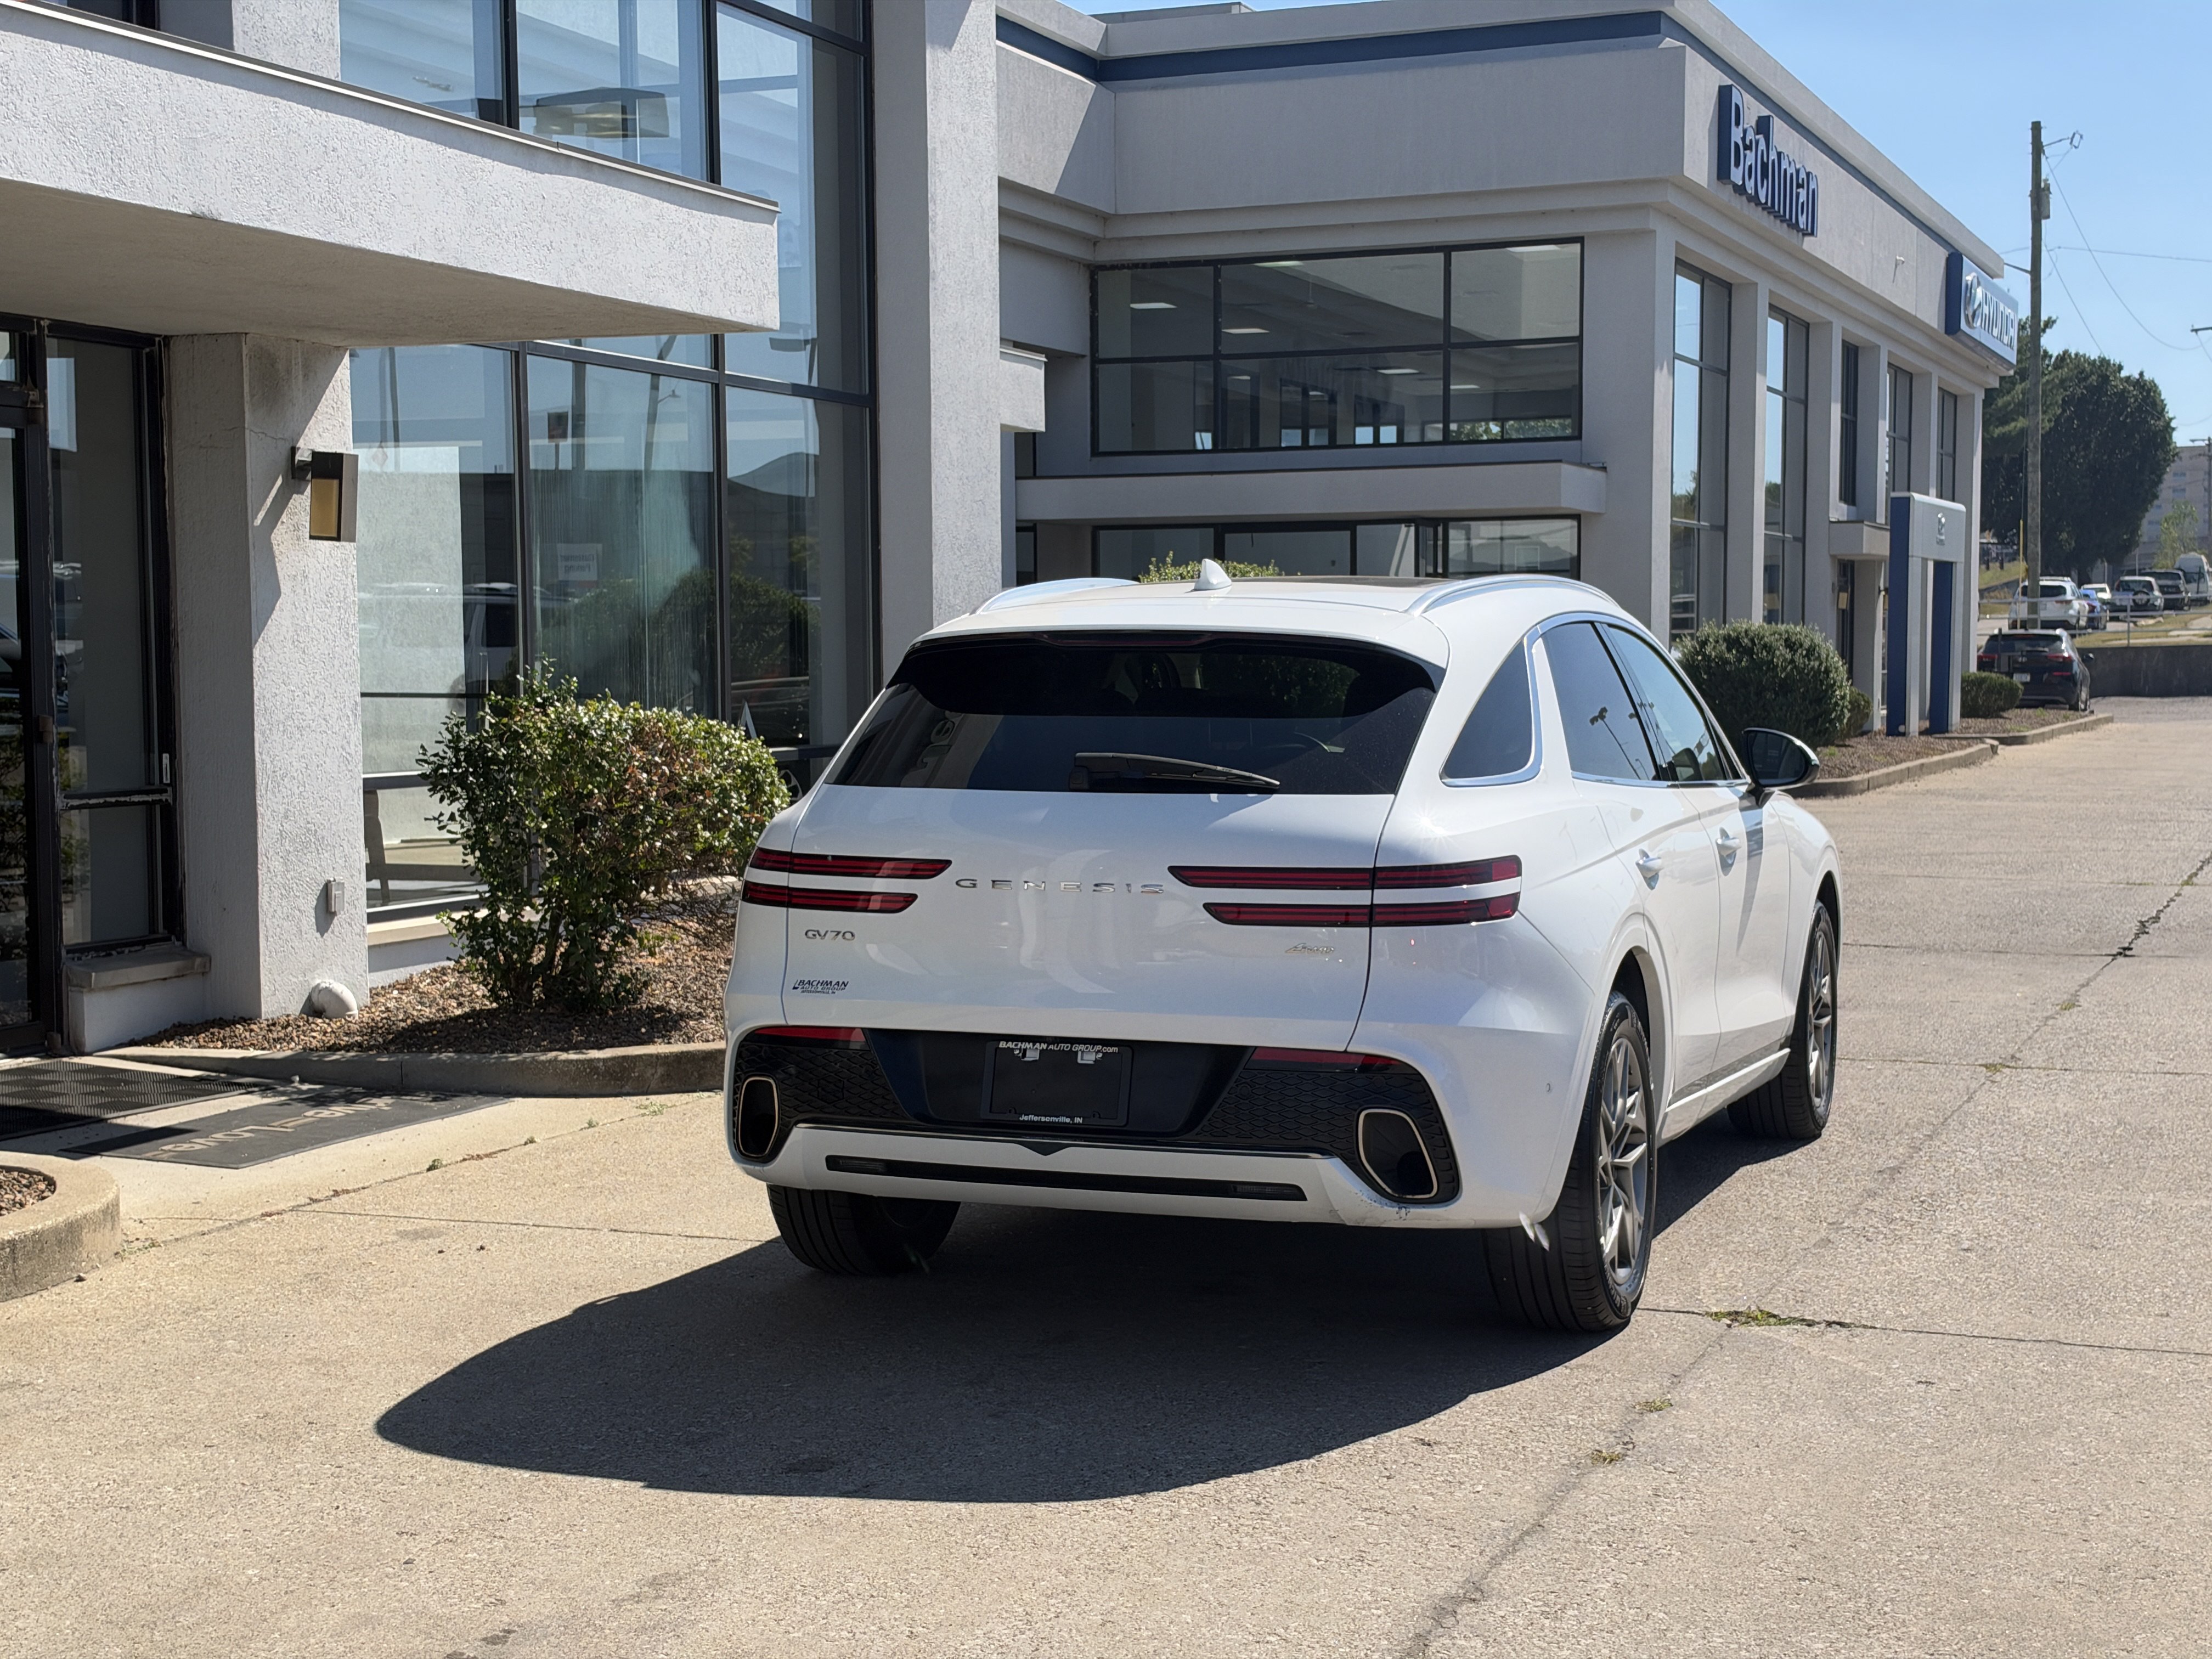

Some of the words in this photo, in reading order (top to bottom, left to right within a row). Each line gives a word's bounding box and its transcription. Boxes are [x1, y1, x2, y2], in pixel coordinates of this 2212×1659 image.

[1718, 84, 1819, 238] Bachman
[955, 878, 1164, 895] GENESIS
[804, 929, 855, 941] GV70
[798, 979, 849, 988] BACHMAN
[998, 1041, 1047, 1050] BACHMAN
[1071, 1044, 1119, 1053] GROUP.com
[1019, 1114, 1073, 1124] Jeffersonville,
